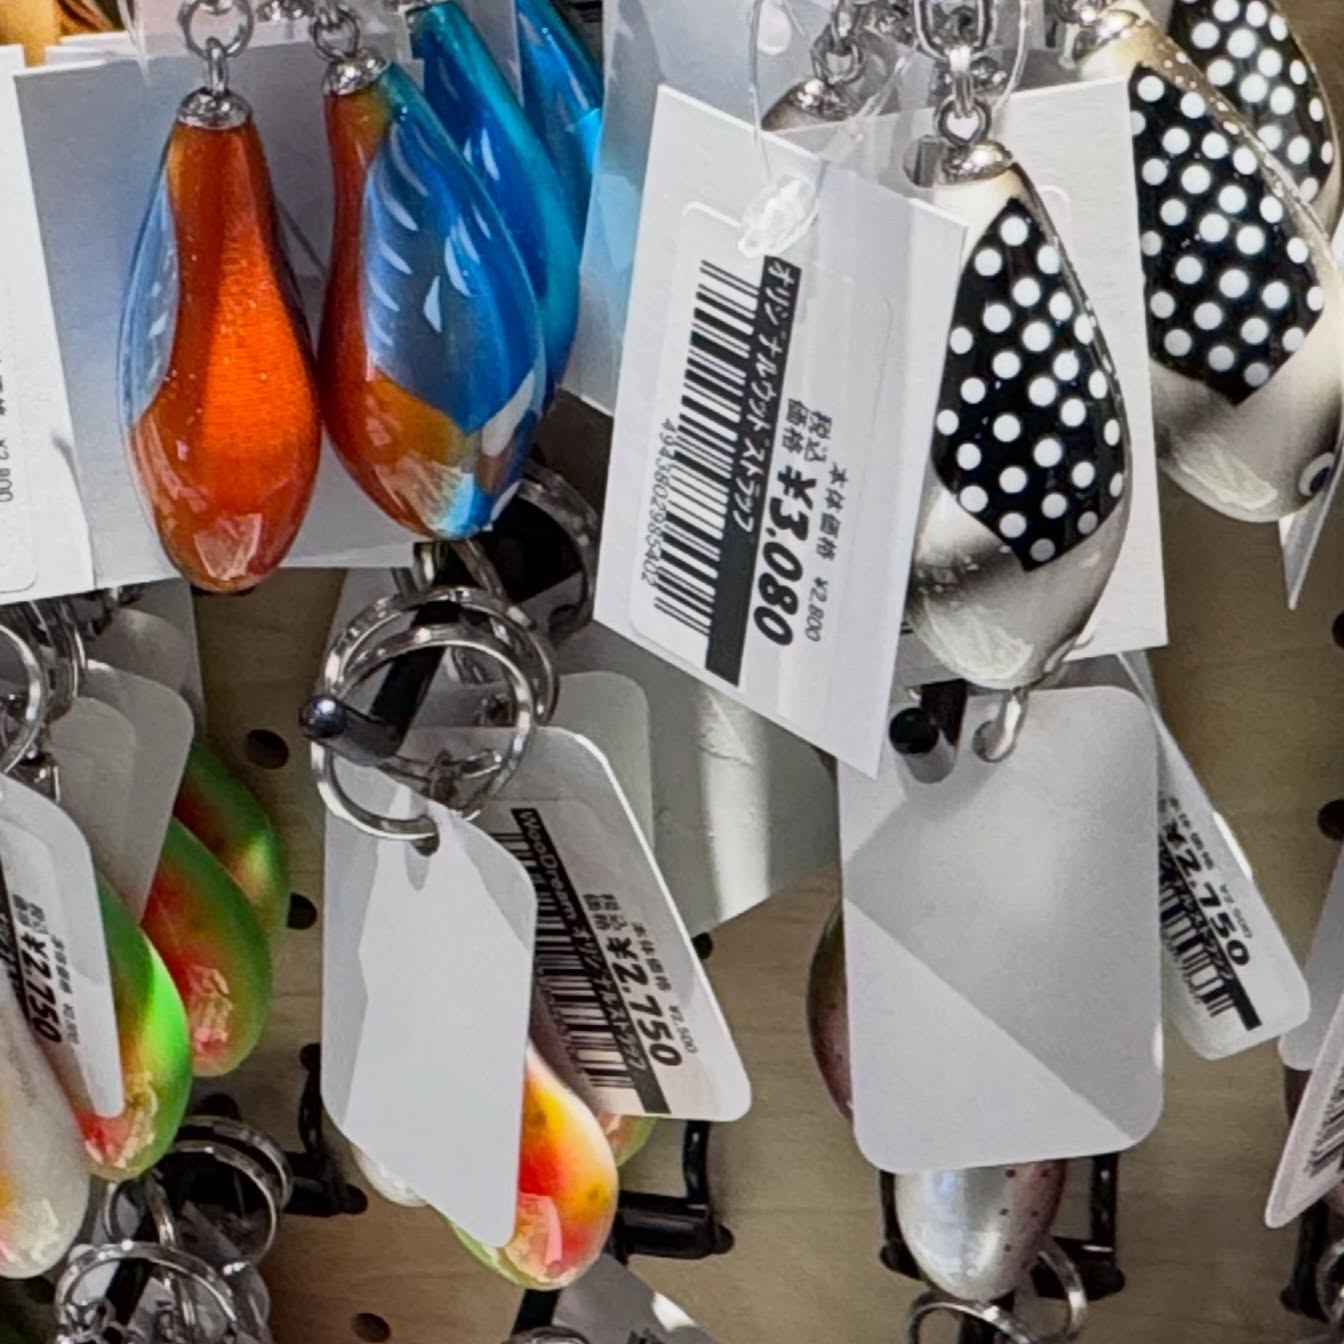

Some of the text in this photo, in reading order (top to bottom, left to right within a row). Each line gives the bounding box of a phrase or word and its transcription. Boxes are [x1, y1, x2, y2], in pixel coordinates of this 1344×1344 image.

[781, 397, 809, 456] 価格
[804, 410, 833, 462] 税込
[815, 463, 849, 561] 本体価格
[753, 464, 817, 647] ¥3,080
